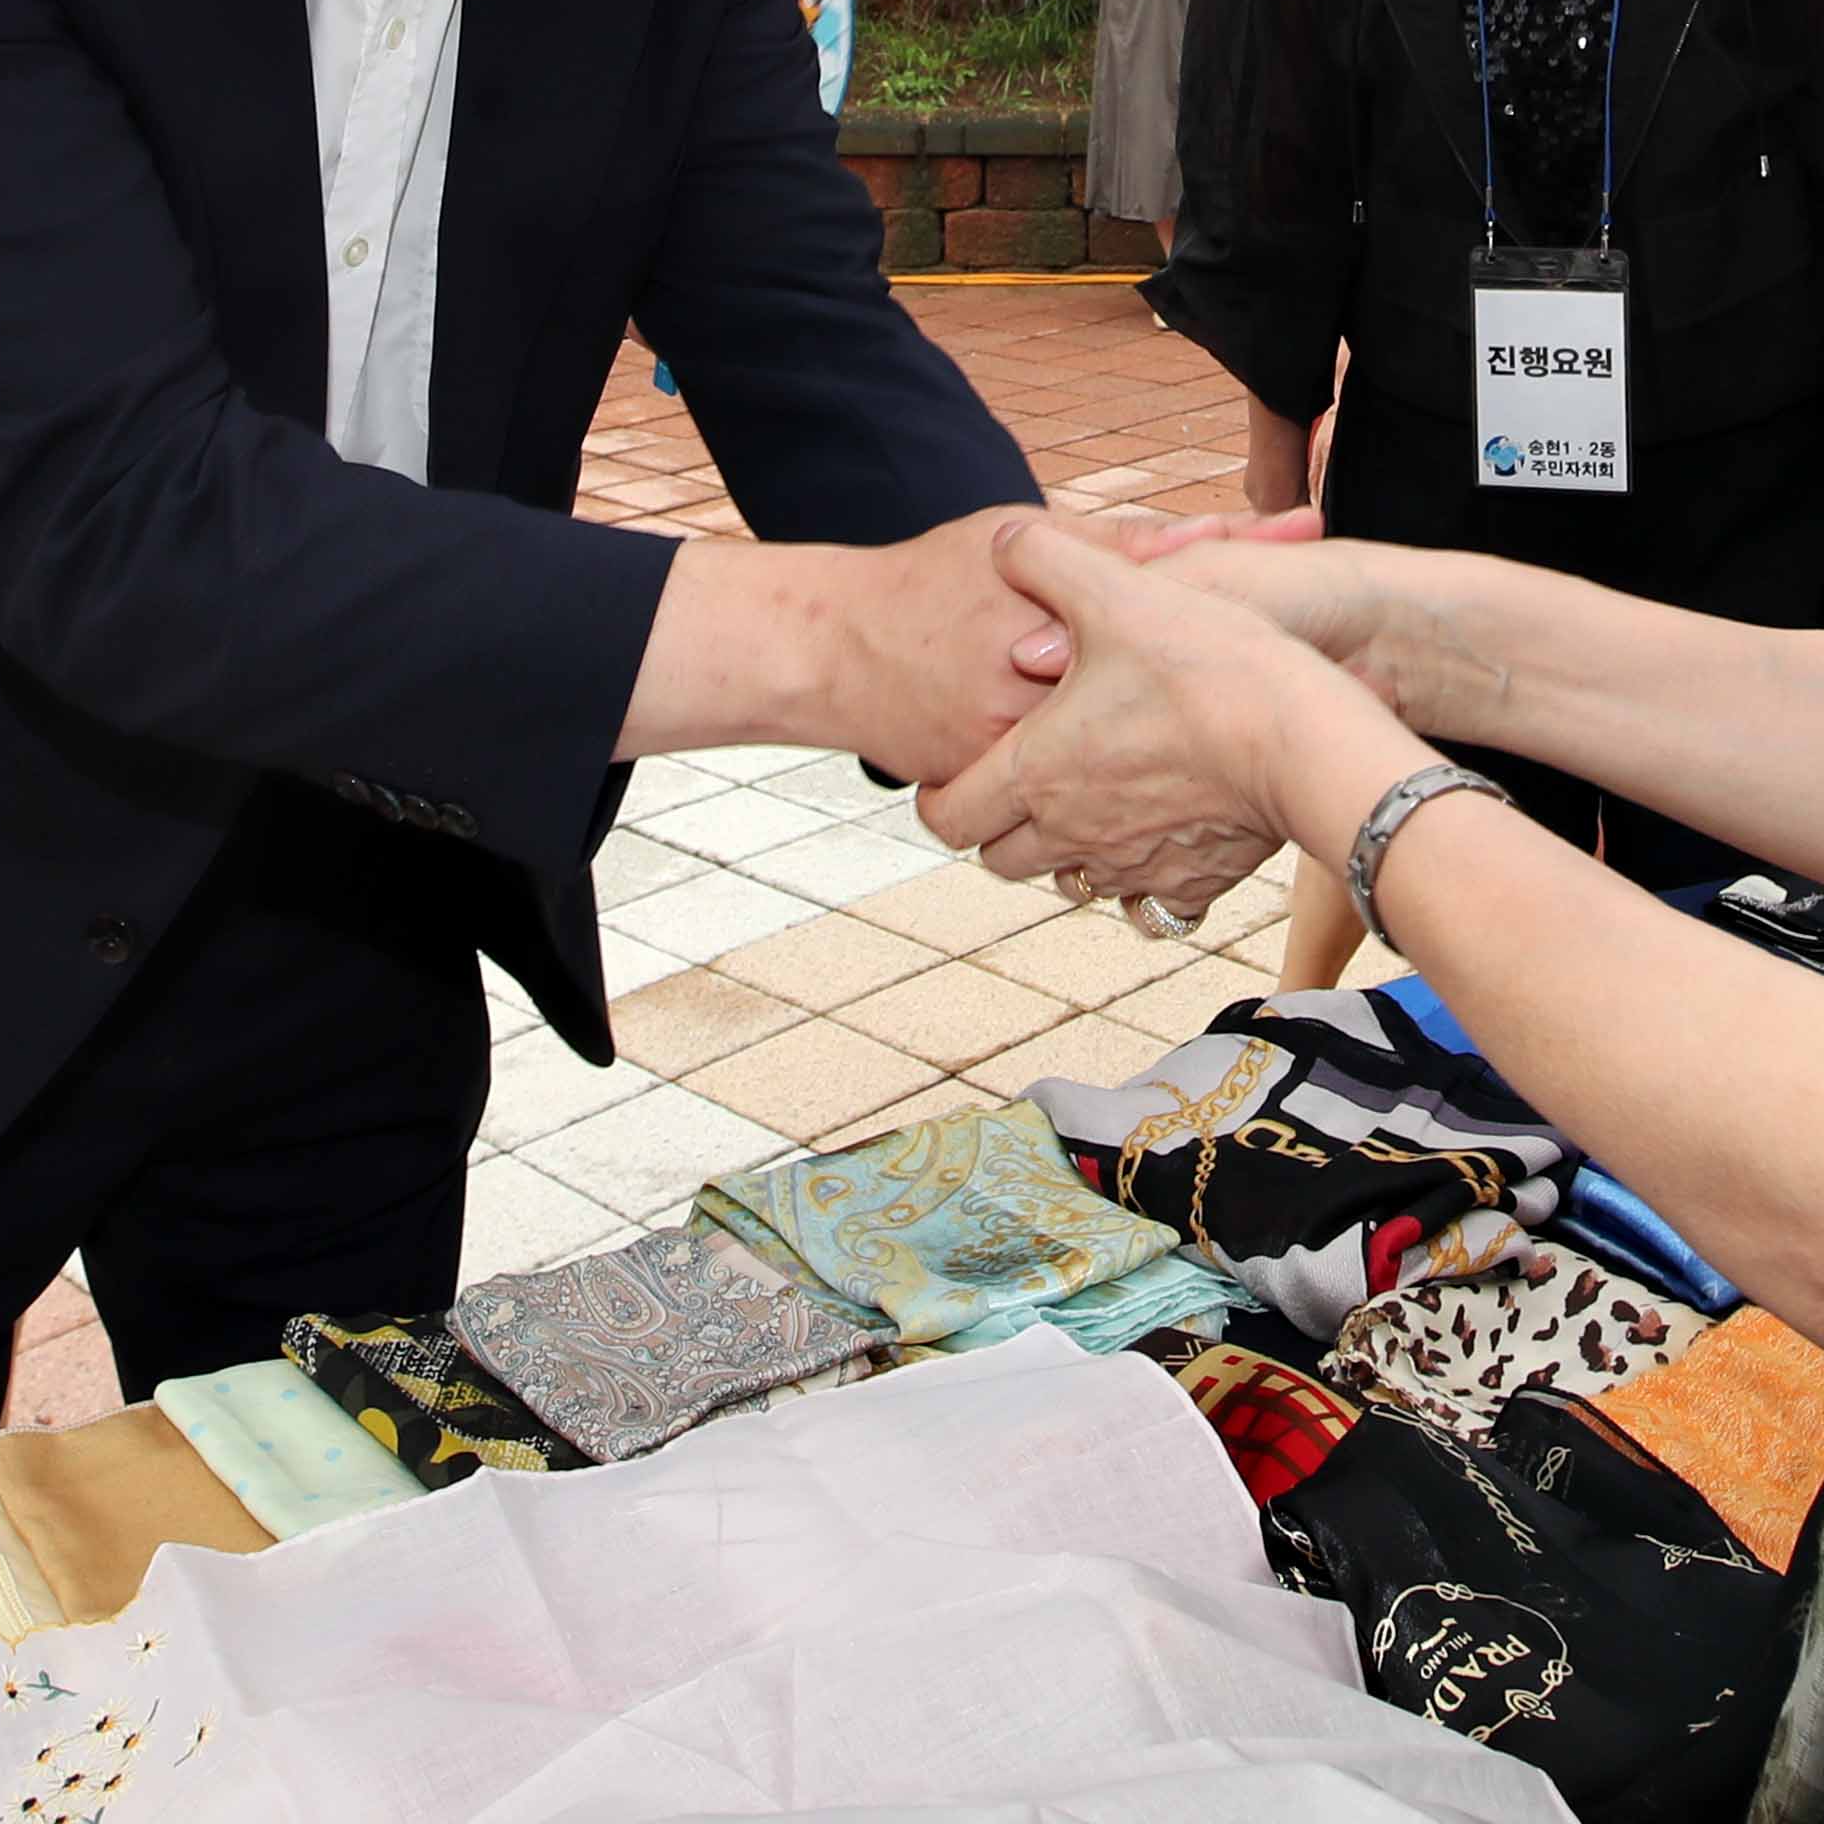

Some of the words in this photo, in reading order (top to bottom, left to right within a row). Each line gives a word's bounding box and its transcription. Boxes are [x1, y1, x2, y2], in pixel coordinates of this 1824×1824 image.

[1487, 345, 1613, 379] 진행요원
[1530, 460, 1615, 479] 주민자치회
[1418, 1631, 1475, 1680] MILANO
